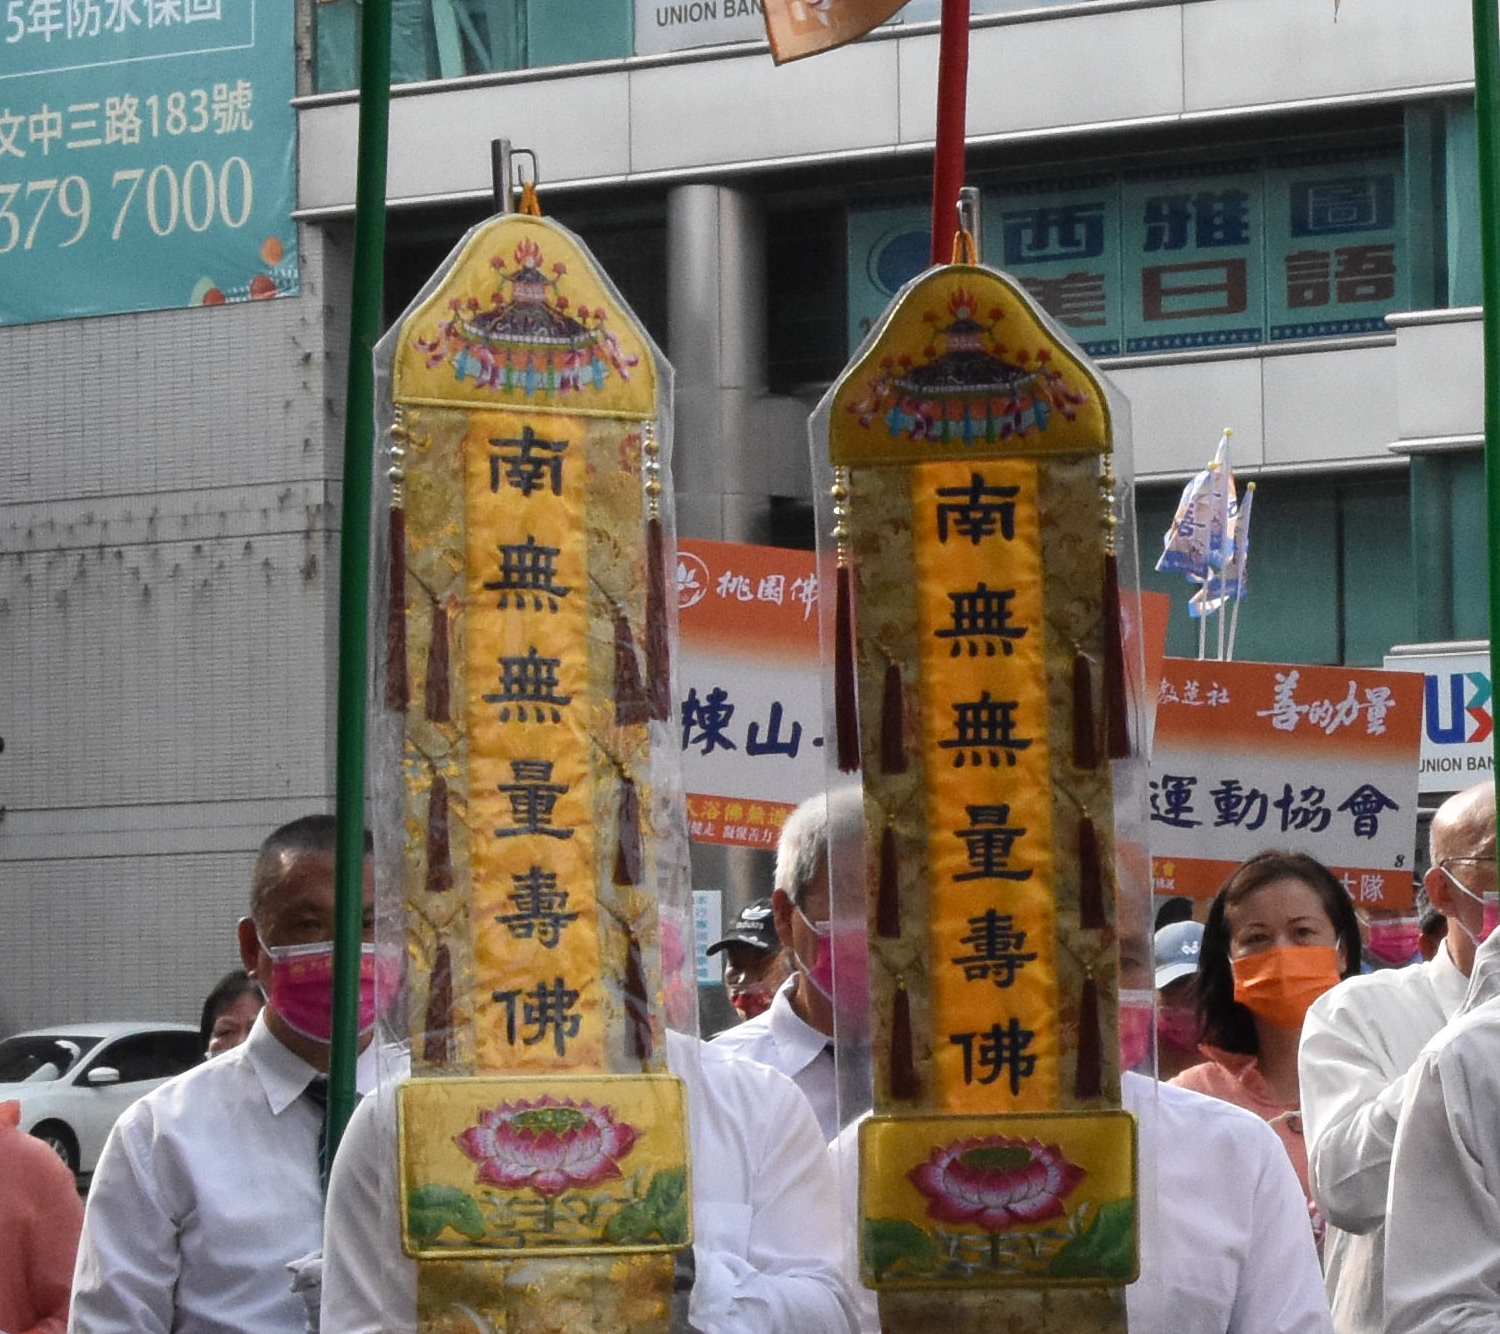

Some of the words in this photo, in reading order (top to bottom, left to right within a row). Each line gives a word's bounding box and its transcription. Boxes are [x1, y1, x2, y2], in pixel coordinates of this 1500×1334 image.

[655, 3, 718, 28] UNION
[109, 156, 255, 242] 7000
[1002, 171, 1397, 267] 西雅圖
[482, 424, 583, 1057] 南無無量壽佛
[1256, 669, 1397, 736] 善的力量
[934, 471, 1037, 1097] 南無無量壽佛
[1149, 773, 1401, 841] 運動協會
